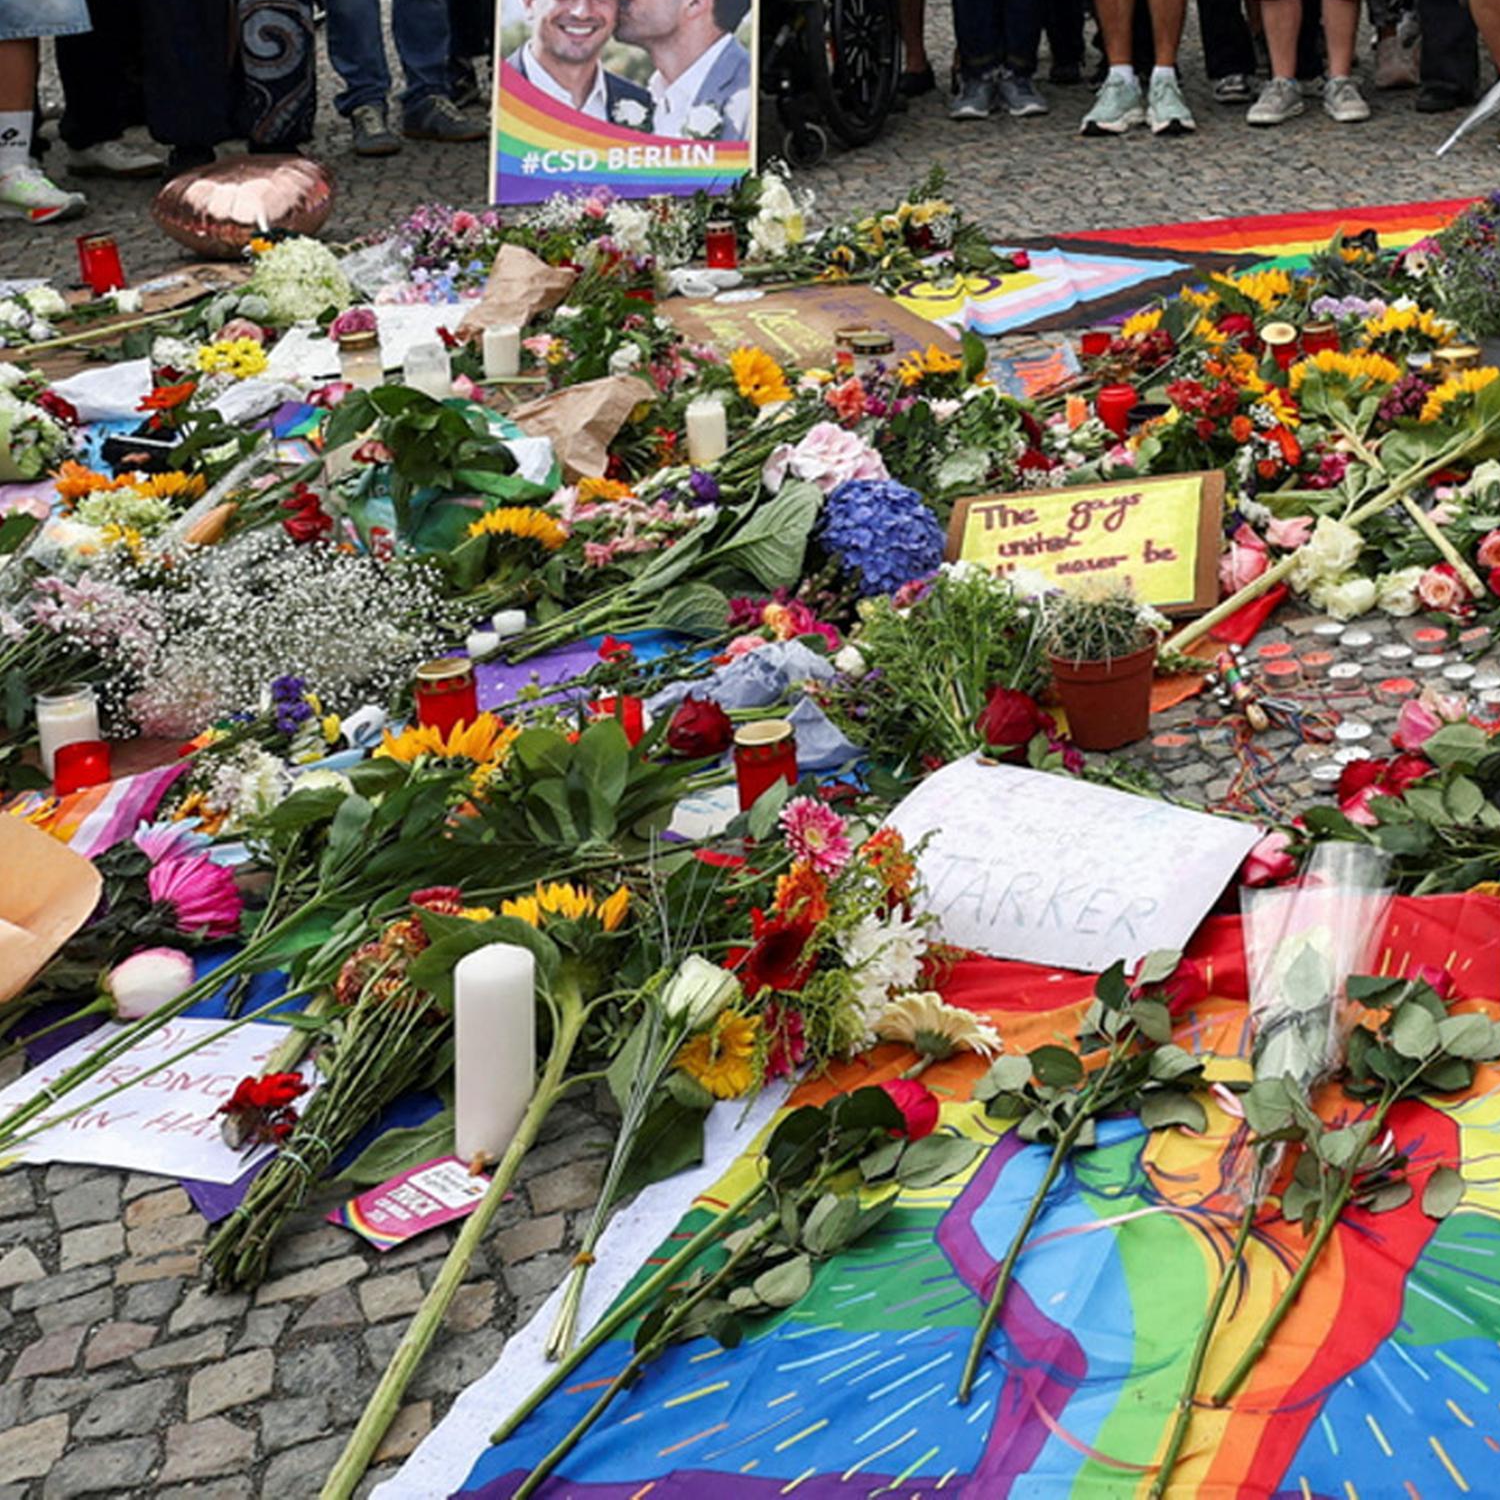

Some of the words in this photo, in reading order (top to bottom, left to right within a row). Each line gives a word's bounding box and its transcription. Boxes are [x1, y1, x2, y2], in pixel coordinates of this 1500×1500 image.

[521, 149, 598, 175] #CSD
[608, 144, 716, 170] BERLIN
[972, 503, 1039, 531] The
[1068, 493, 1143, 532] gays
[998, 532, 1082, 558] united
[1143, 539, 1178, 564] be
